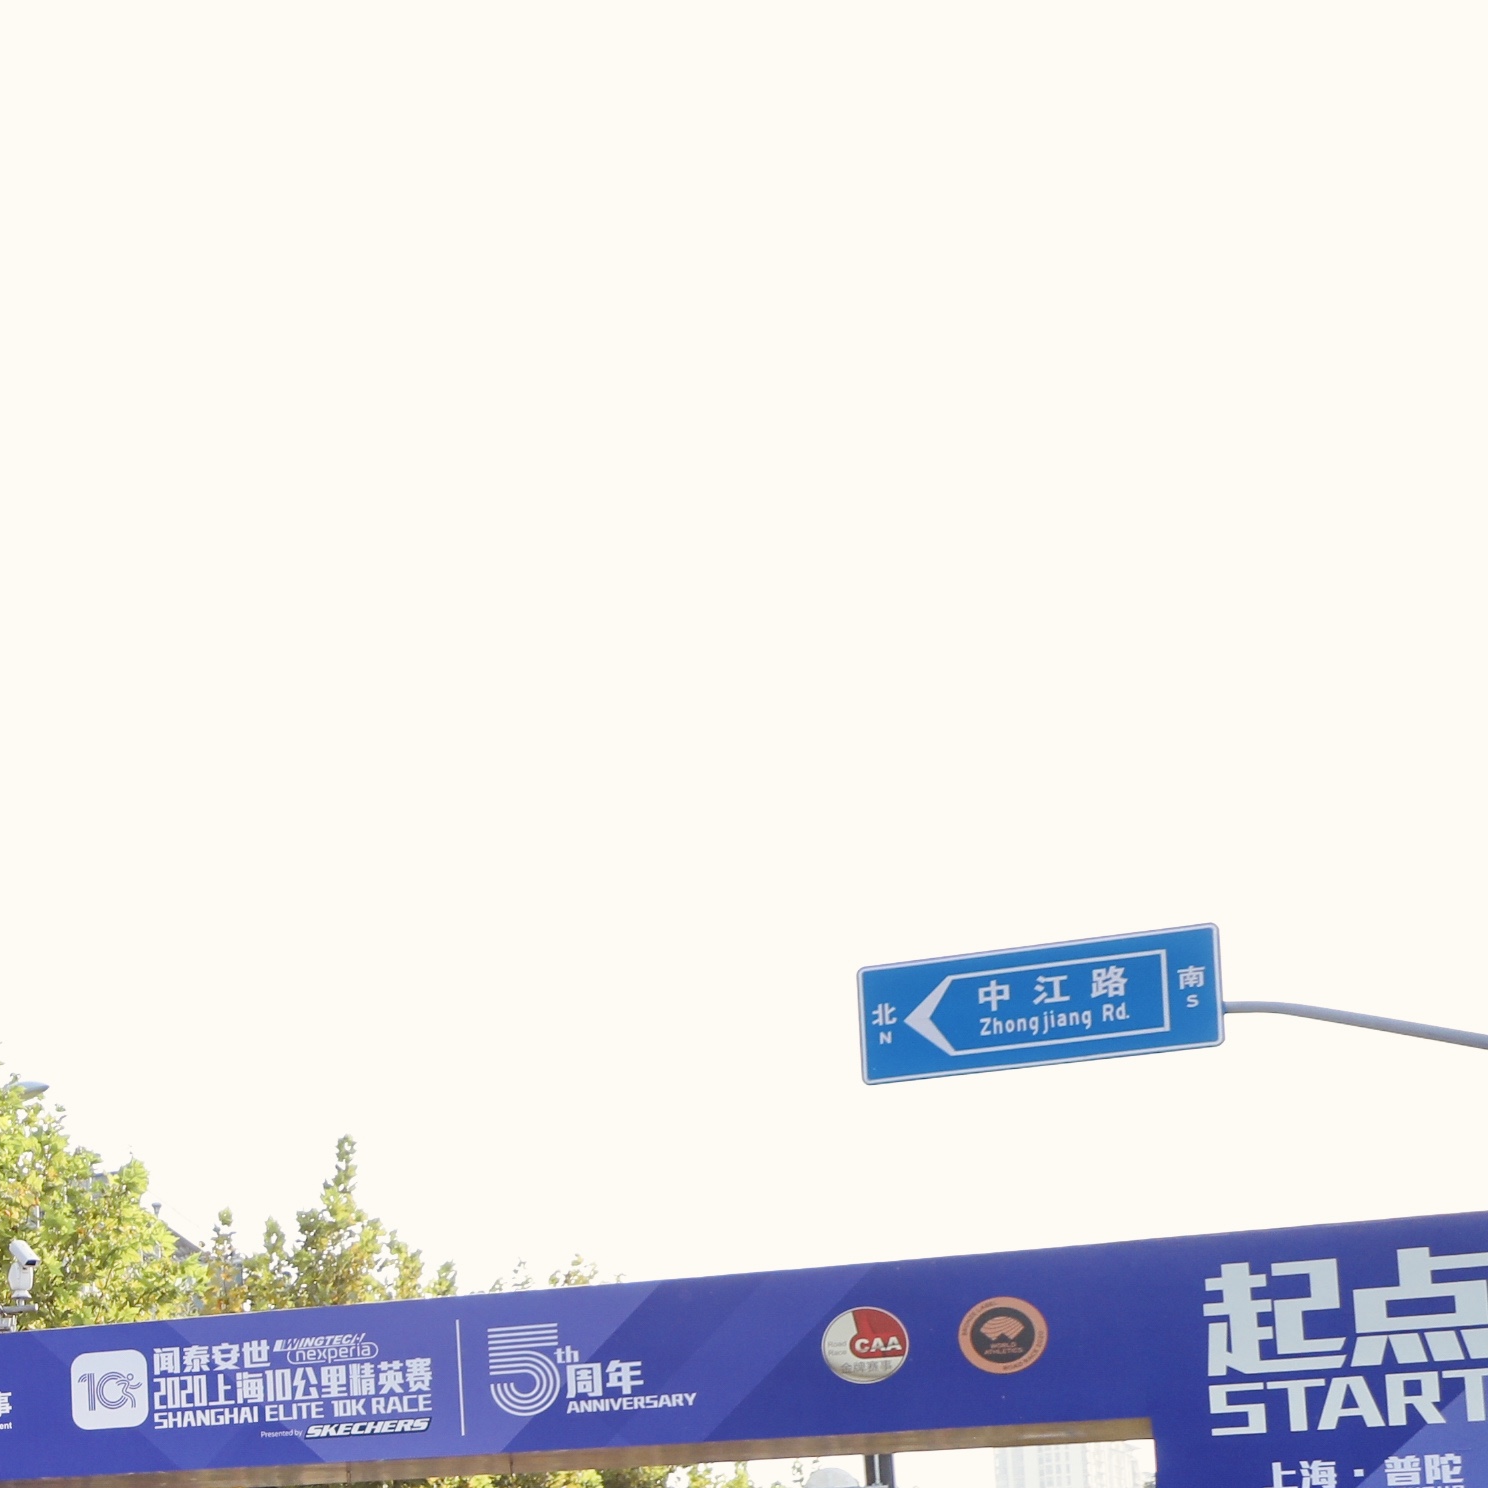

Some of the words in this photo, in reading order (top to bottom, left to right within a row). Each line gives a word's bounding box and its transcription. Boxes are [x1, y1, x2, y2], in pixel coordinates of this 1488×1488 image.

[1177, 965, 1205, 989] 南
[978, 966, 1128, 1012] 中江路
[1186, 993, 1199, 1008] S
[872, 1003, 897, 1025] 北
[980, 1005, 1092, 1036] Zhongjiang
[1102, 1003, 1129, 1022] Rd.
[880, 1031, 892, 1044] N
[1203, 1247, 1488, 1377] 起点
[273, 1333, 366, 1352] WINGTECH
[296, 1343, 372, 1364] nexperia
[854, 1336, 902, 1353] CAA
[153, 1339, 271, 1375] 闻泰安世
[841, 1360, 892, 1374] 金牌赛事
[153, 1357, 433, 1410] 2020上海10公里精英赛
[565, 1360, 644, 1398] 周年
[154, 1405, 259, 1430] SHANGHAI
[265, 1400, 324, 1422] ELITE
[333, 1398, 366, 1417] 10K
[372, 1394, 433, 1414] RACE
[566, 1392, 697, 1414] ANNIVERSARY
[1209, 1367, 1488, 1436] START
[260, 1429, 293, 1439] Presented
[306, 1417, 430, 1439] SKECHERS
